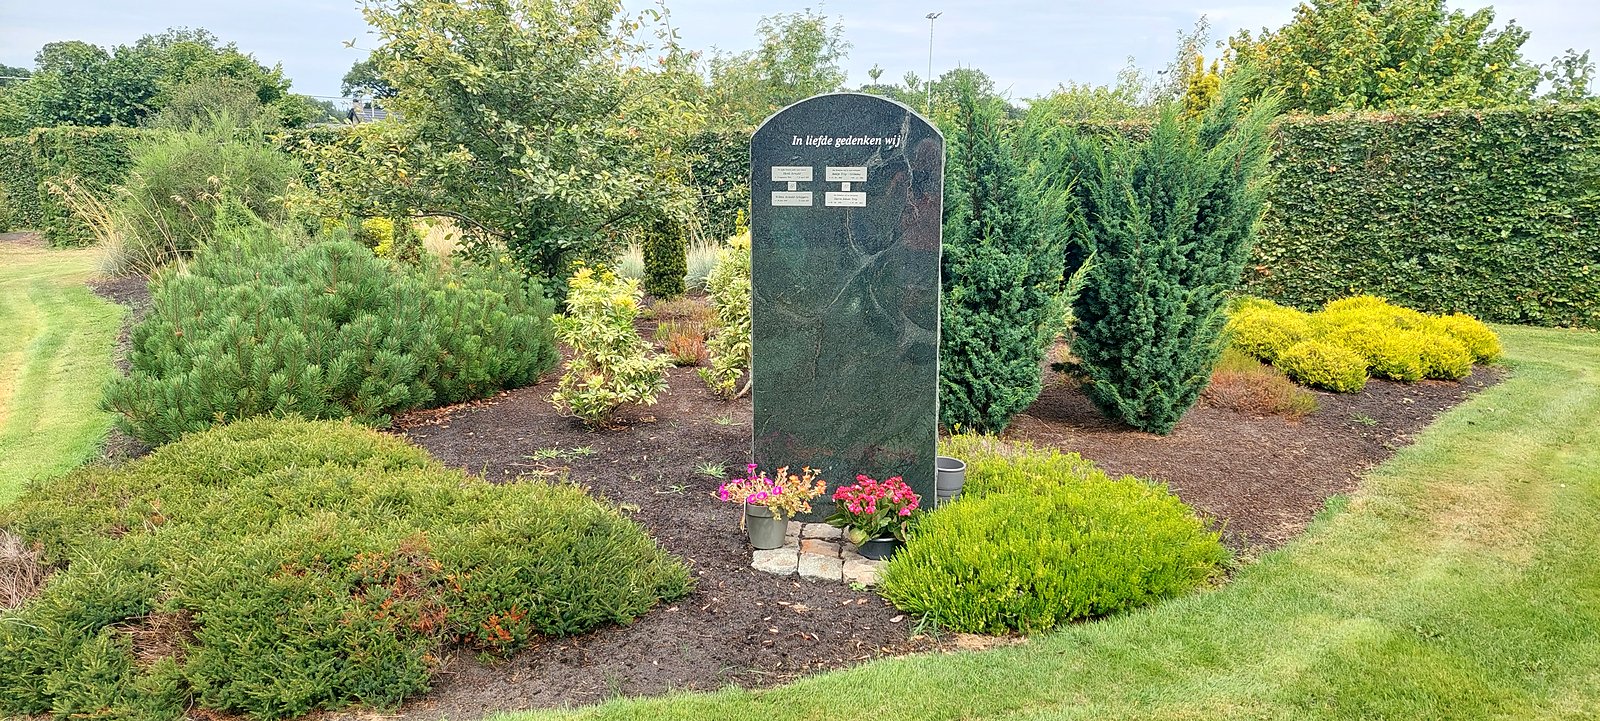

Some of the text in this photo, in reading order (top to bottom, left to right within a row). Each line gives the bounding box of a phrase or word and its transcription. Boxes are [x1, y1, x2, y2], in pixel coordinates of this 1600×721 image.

[792, 135, 901, 147] In liefde gedenken wij
